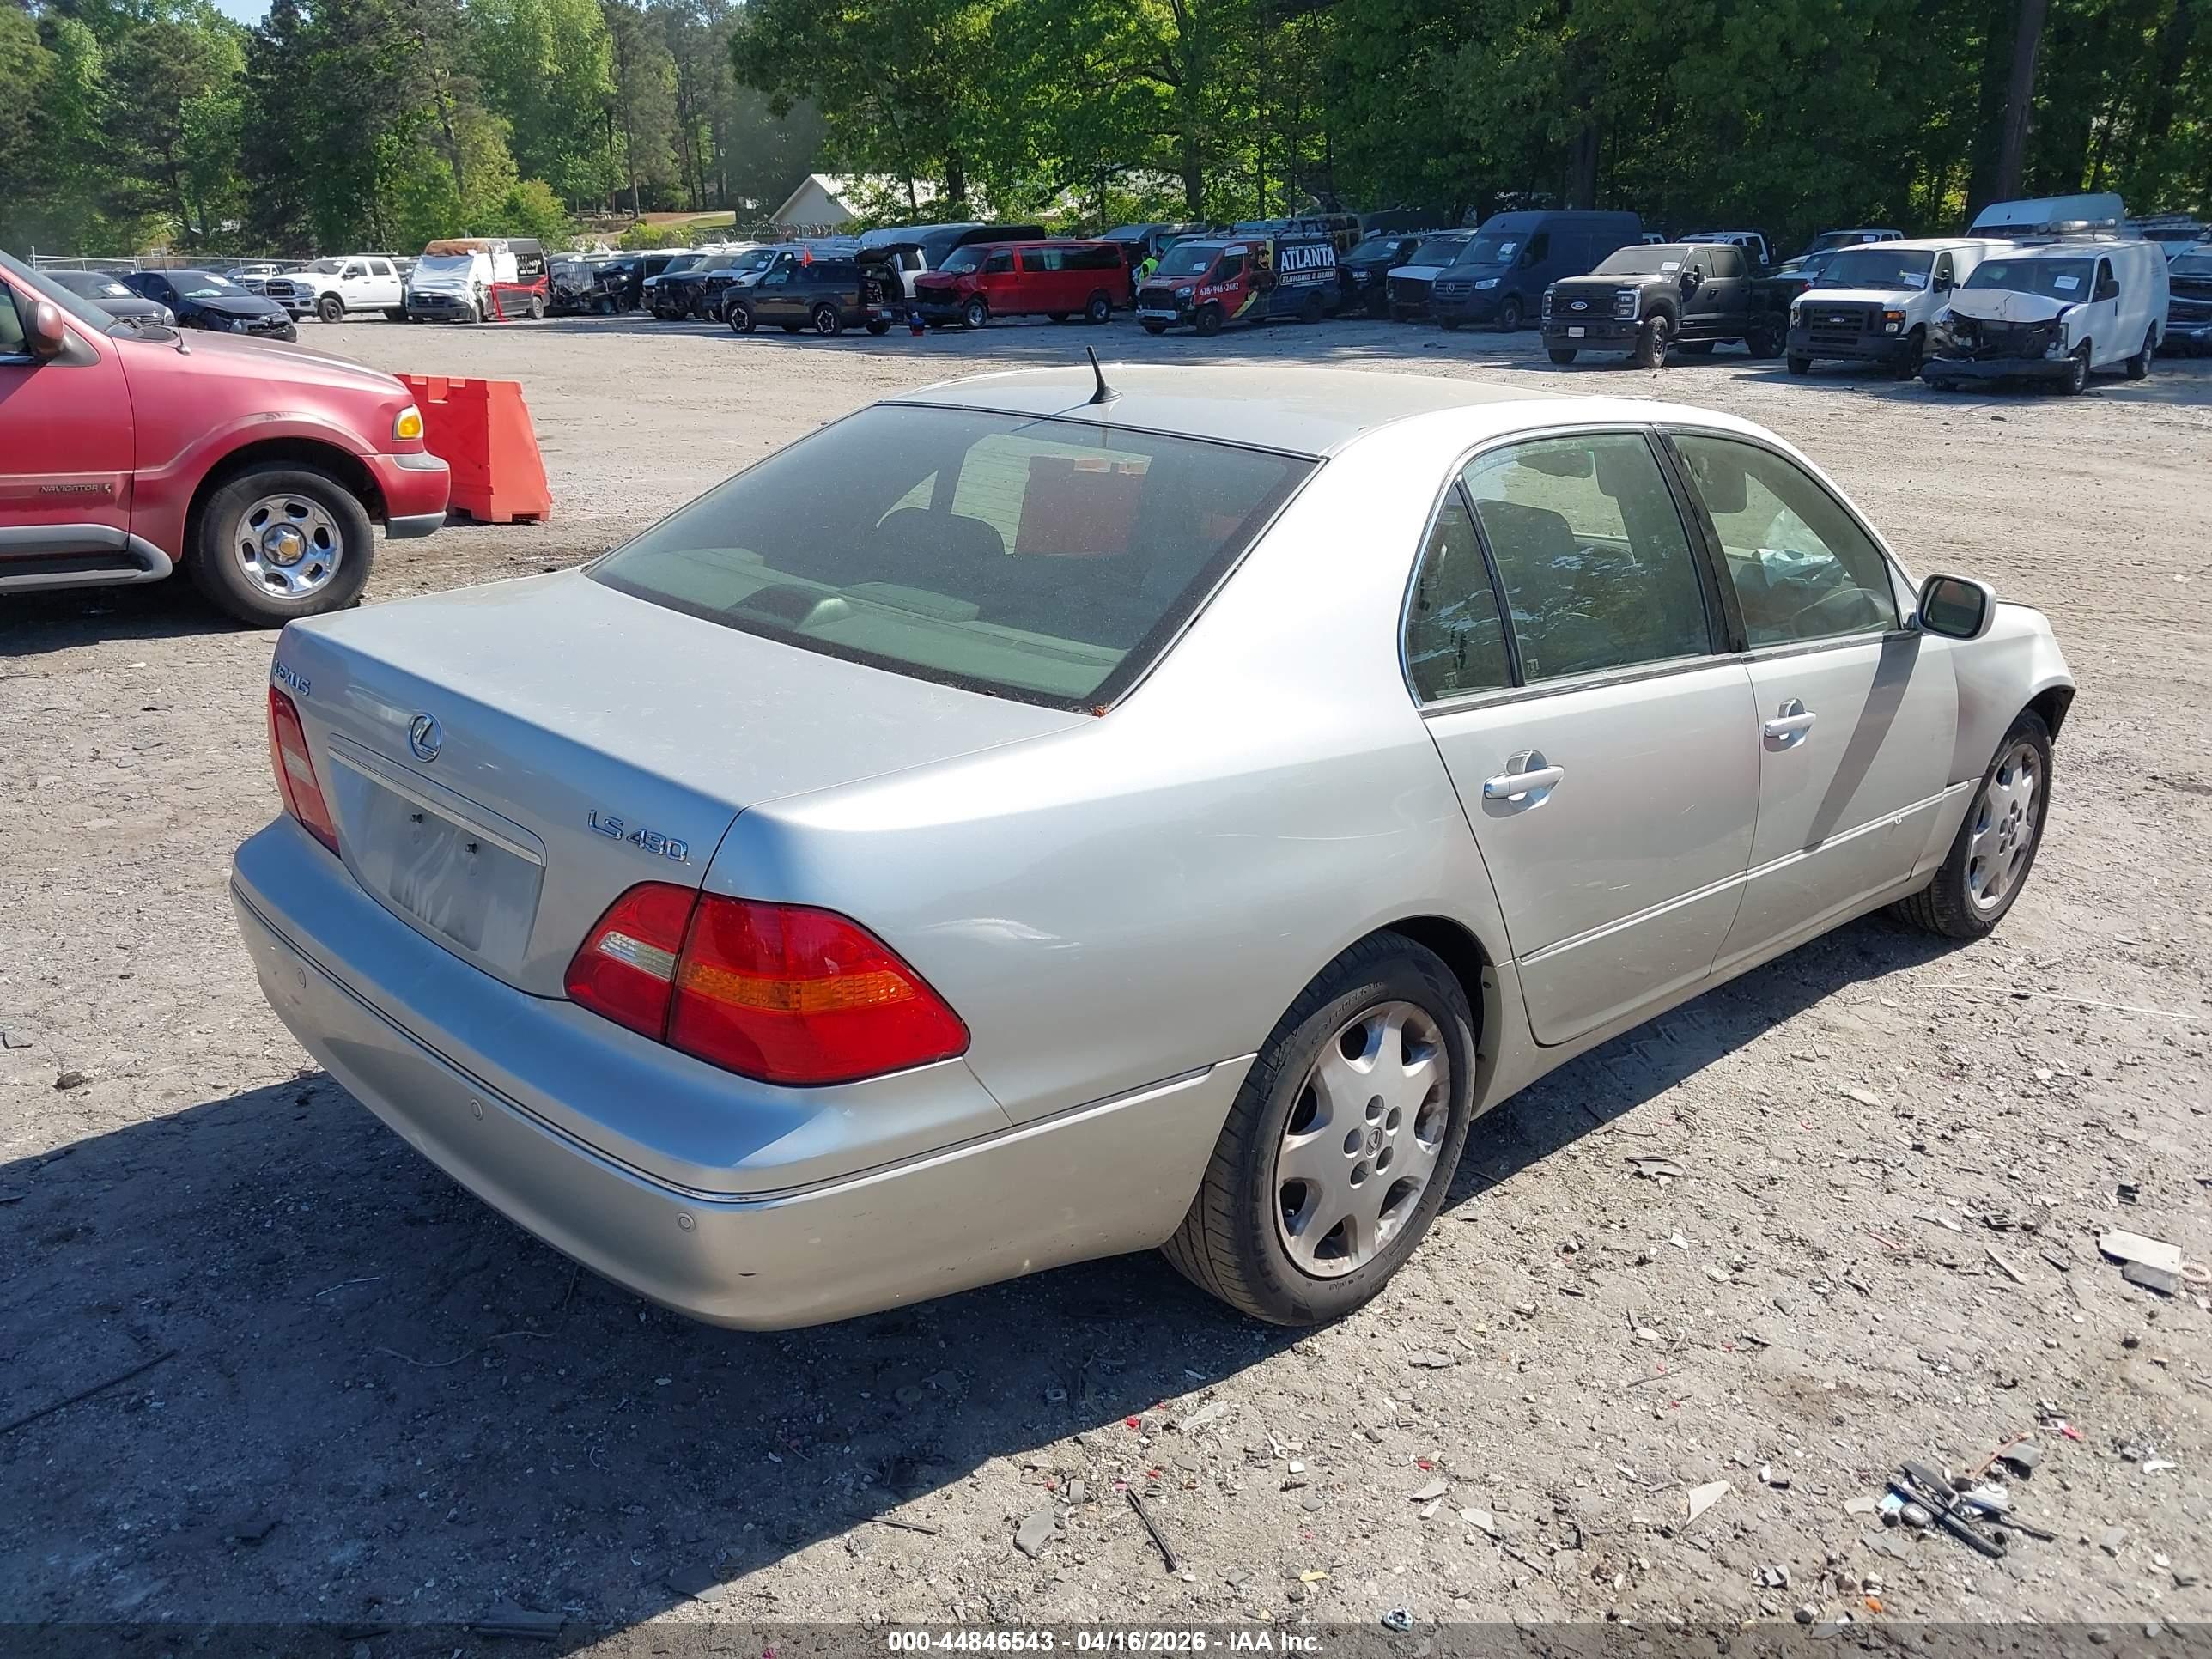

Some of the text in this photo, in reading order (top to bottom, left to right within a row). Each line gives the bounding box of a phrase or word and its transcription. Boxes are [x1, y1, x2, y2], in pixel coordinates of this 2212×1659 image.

[1280, 246, 1336, 272] ATLANTA
[40, 484, 99, 494] NAVIGATOR
[274, 659, 311, 696] LEXUS
[587, 809, 689, 863] LS 430
